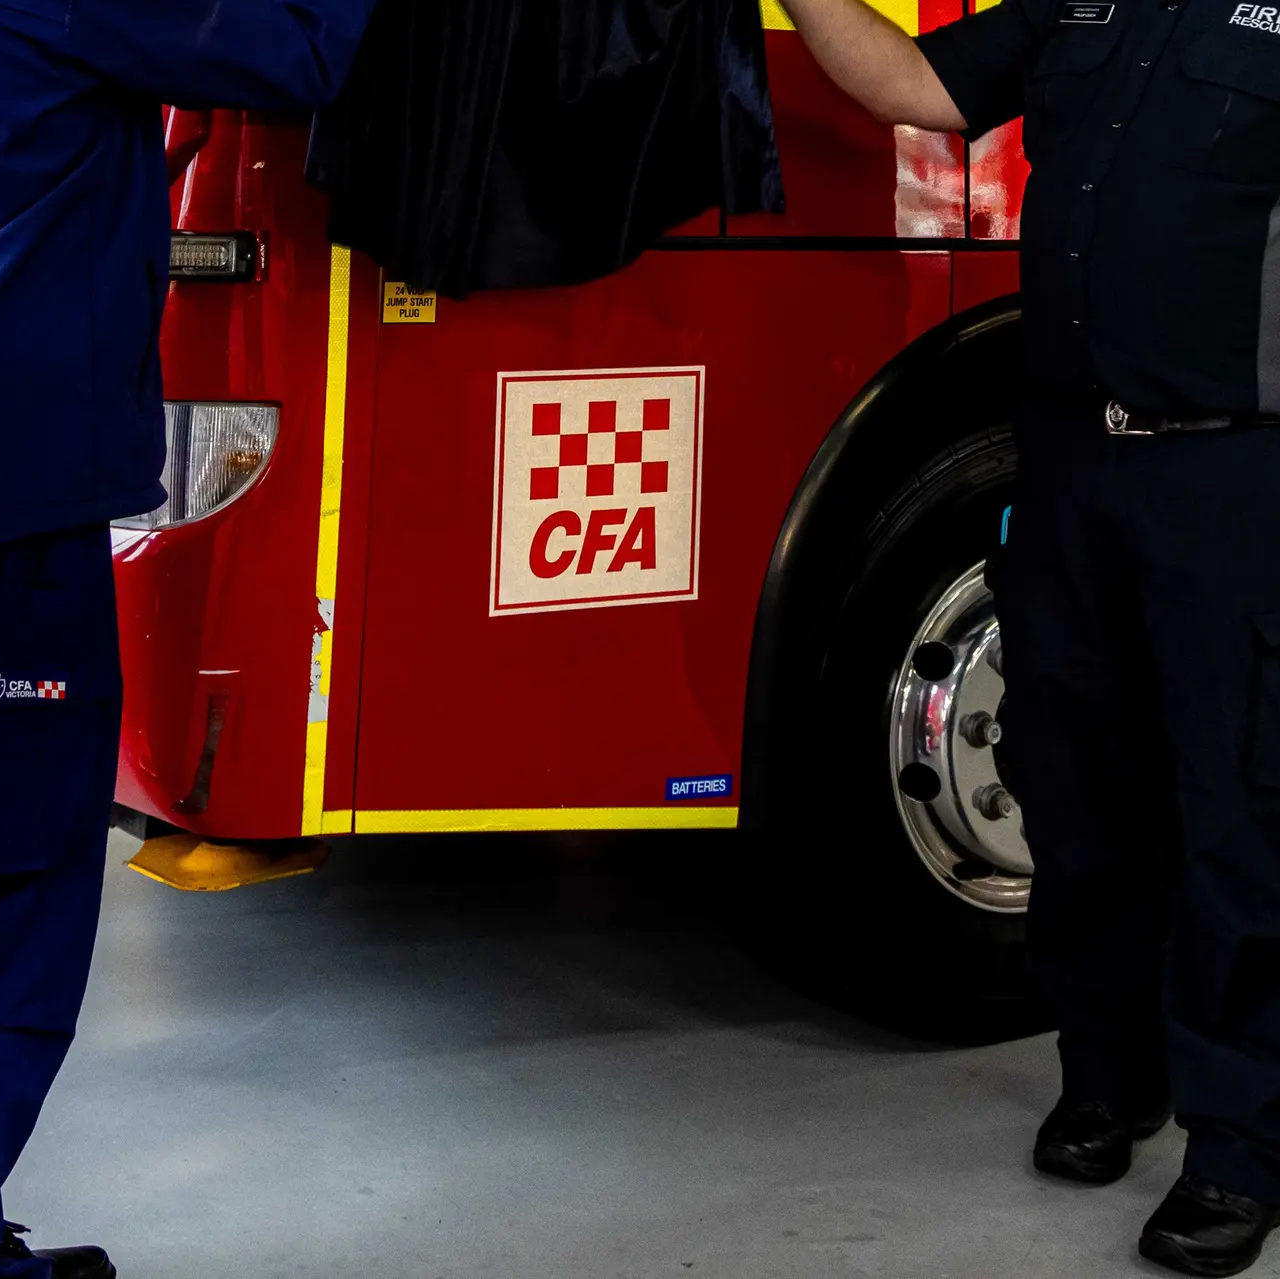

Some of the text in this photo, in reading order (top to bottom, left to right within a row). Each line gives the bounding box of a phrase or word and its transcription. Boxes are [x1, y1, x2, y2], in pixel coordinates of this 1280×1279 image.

[396, 287, 404, 295] 24
[386, 298, 434, 307] JUMP START
[400, 309, 419, 318] PLUG
[529, 506, 656, 578] CFA
[9, 680, 32, 691] CFA
[5, 690, 36, 698] VICTORIA
[672, 779, 726, 795] BATTERIES
